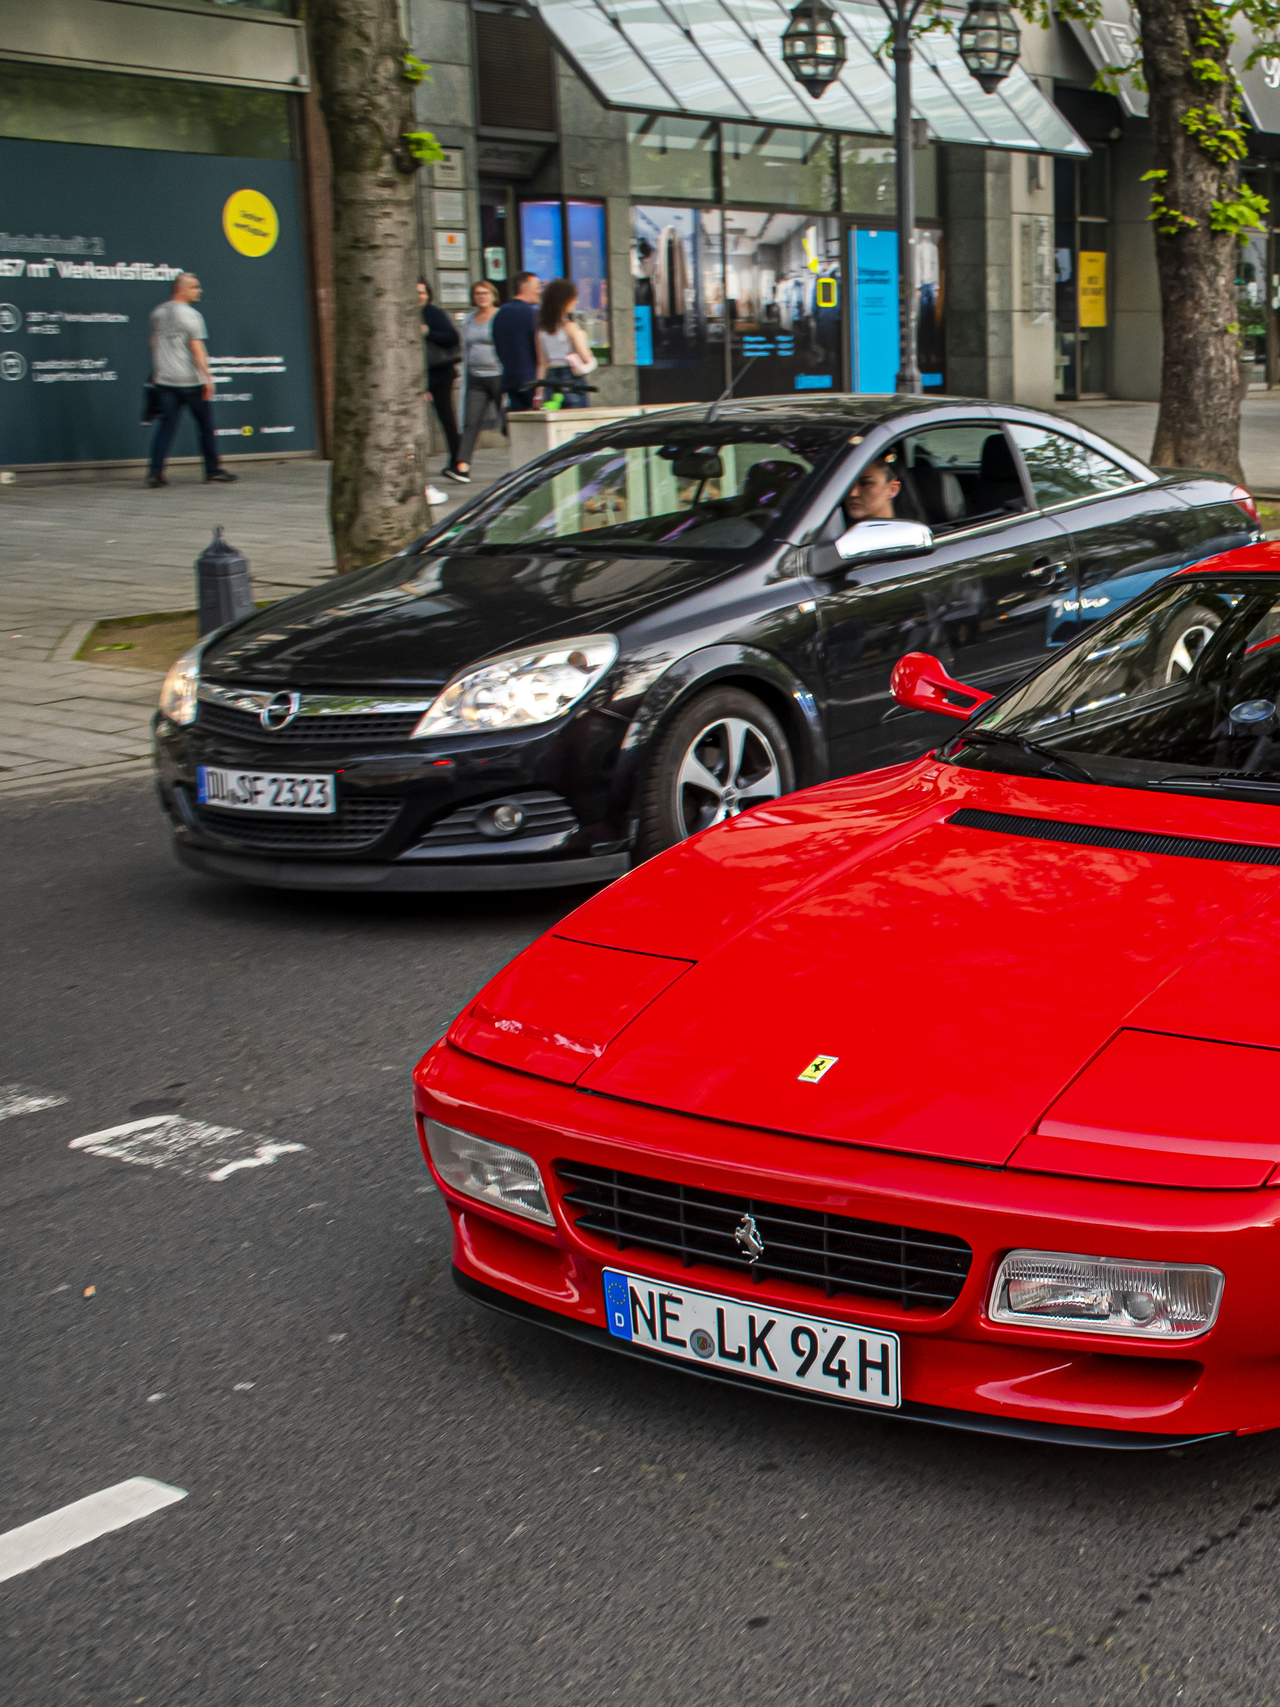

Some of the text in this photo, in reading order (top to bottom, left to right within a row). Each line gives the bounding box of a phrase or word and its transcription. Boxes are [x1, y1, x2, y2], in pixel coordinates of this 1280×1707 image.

[236, 775, 264, 805] SF
[268, 777, 329, 808] 2323
[629, 1285, 890, 1397] NE LK 94H
